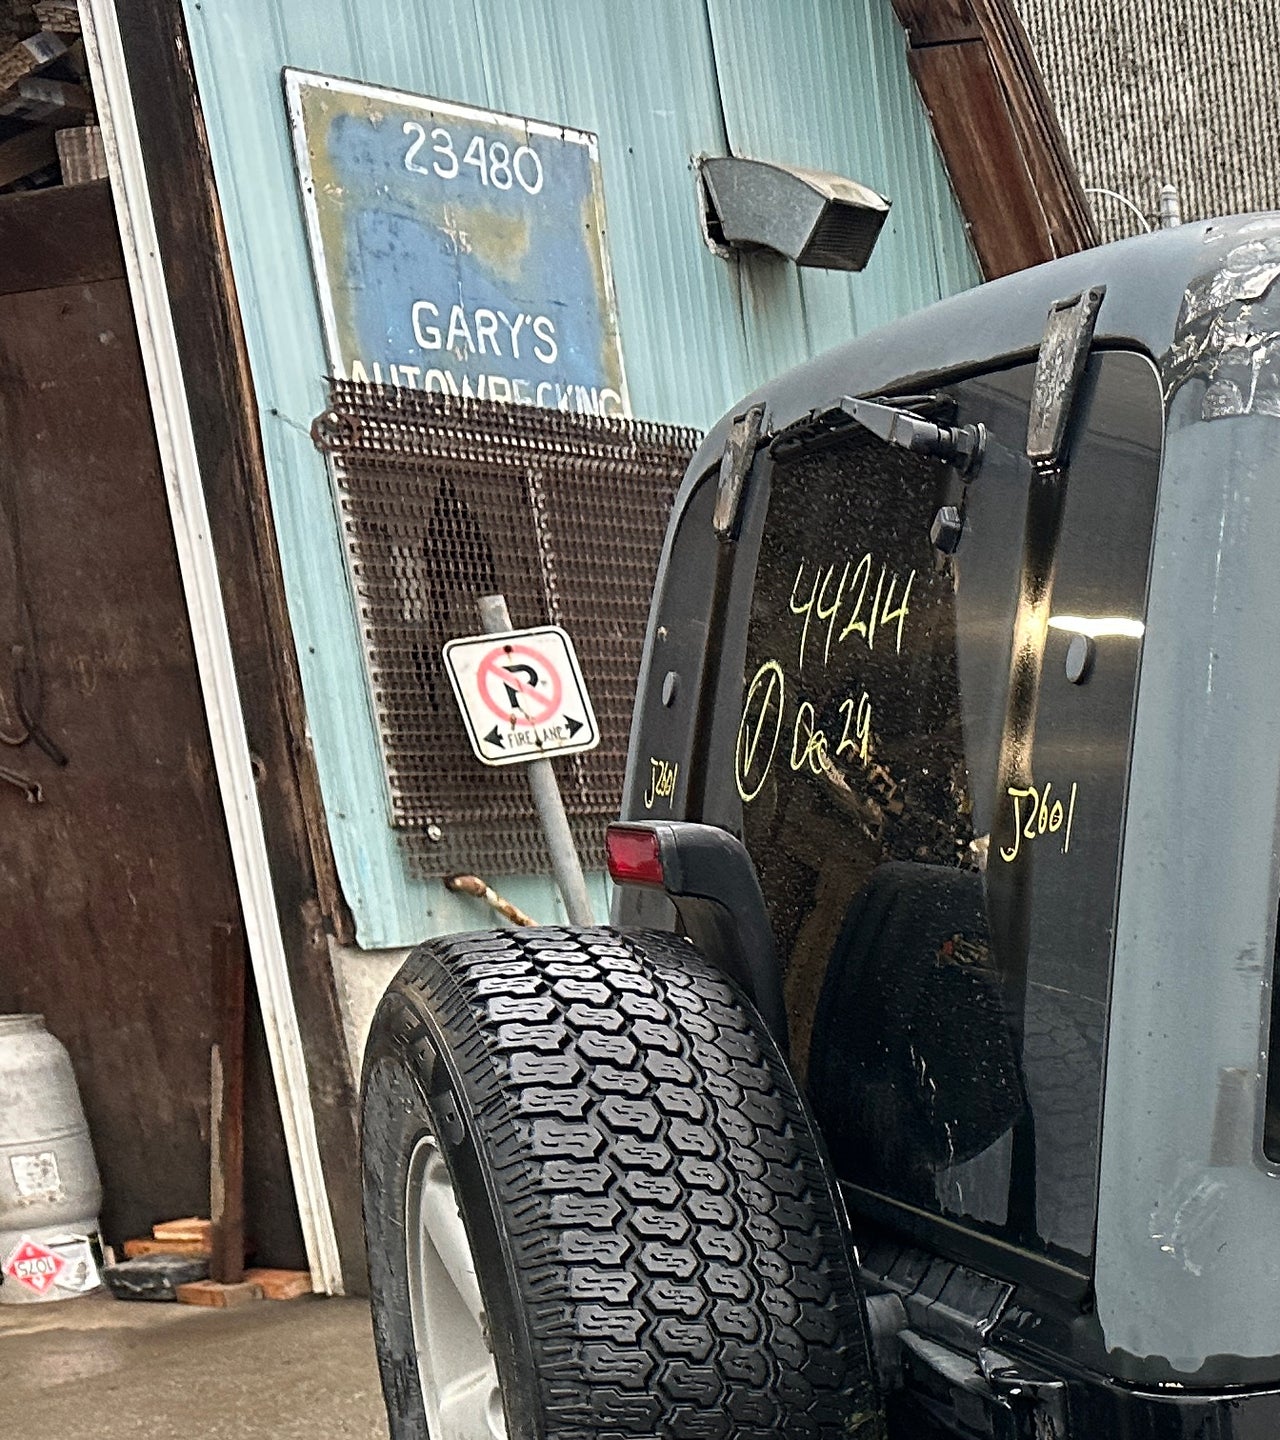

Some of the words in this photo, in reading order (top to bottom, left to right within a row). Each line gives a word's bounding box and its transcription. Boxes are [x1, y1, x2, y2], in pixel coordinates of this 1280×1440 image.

[403, 121, 543, 194] 23480
[411, 300, 559, 365] GARY'S
[789, 552, 916, 670] 44214
[507, 730, 531, 749] FIRE
[836, 691, 872, 766] 29
[1000, 782, 1077, 862] J2601
